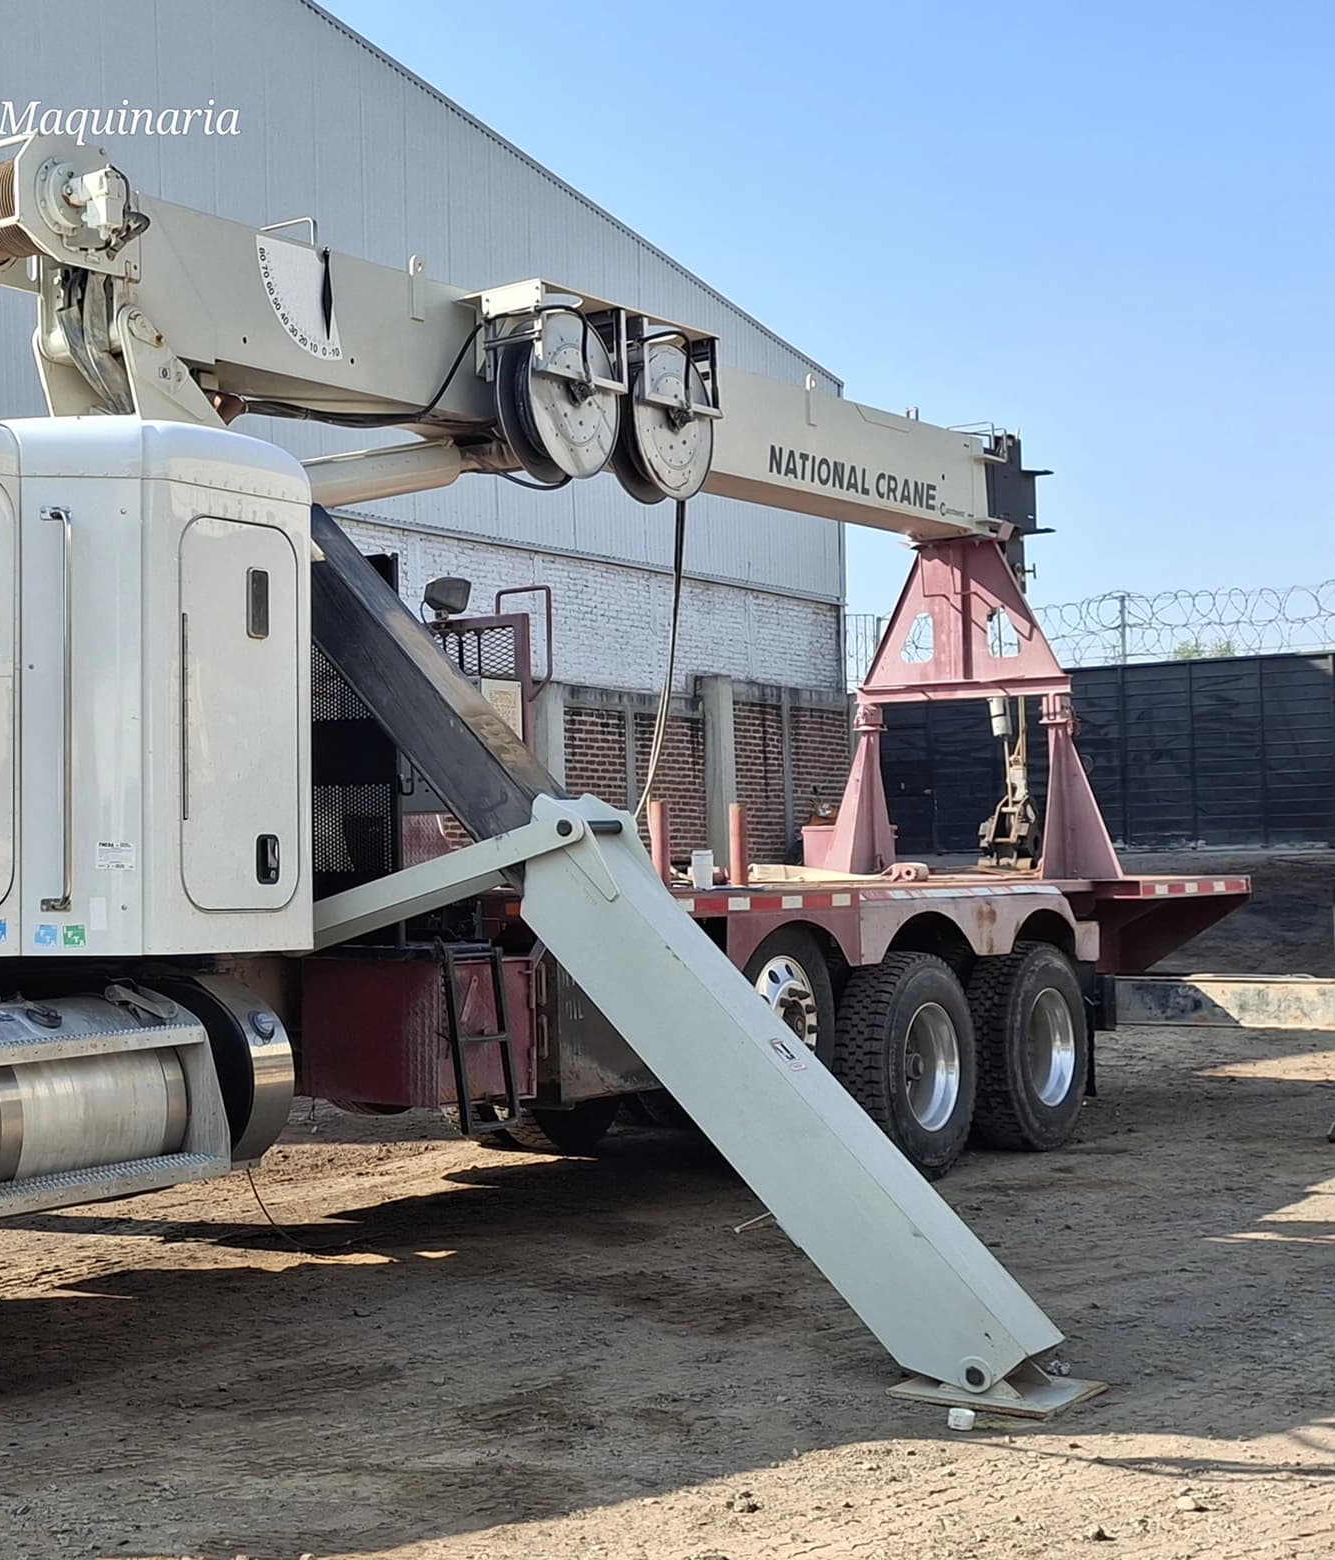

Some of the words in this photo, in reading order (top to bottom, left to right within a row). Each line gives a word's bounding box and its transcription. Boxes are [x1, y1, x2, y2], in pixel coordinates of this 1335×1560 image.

[259, 247, 266, 261] 80
[262, 265, 270, 278] 70
[266, 281, 275, 295] 60
[272, 297, 281, 311] 50
[280, 312, 289, 325] 40
[288, 324, 298, 337] 30
[298, 334, 308, 346] 20
[310, 342, 319, 353] 10
[321, 346, 328, 357] 0
[768, 444, 870, 496] NATIONAL
[875, 472, 937, 511] CRANE
